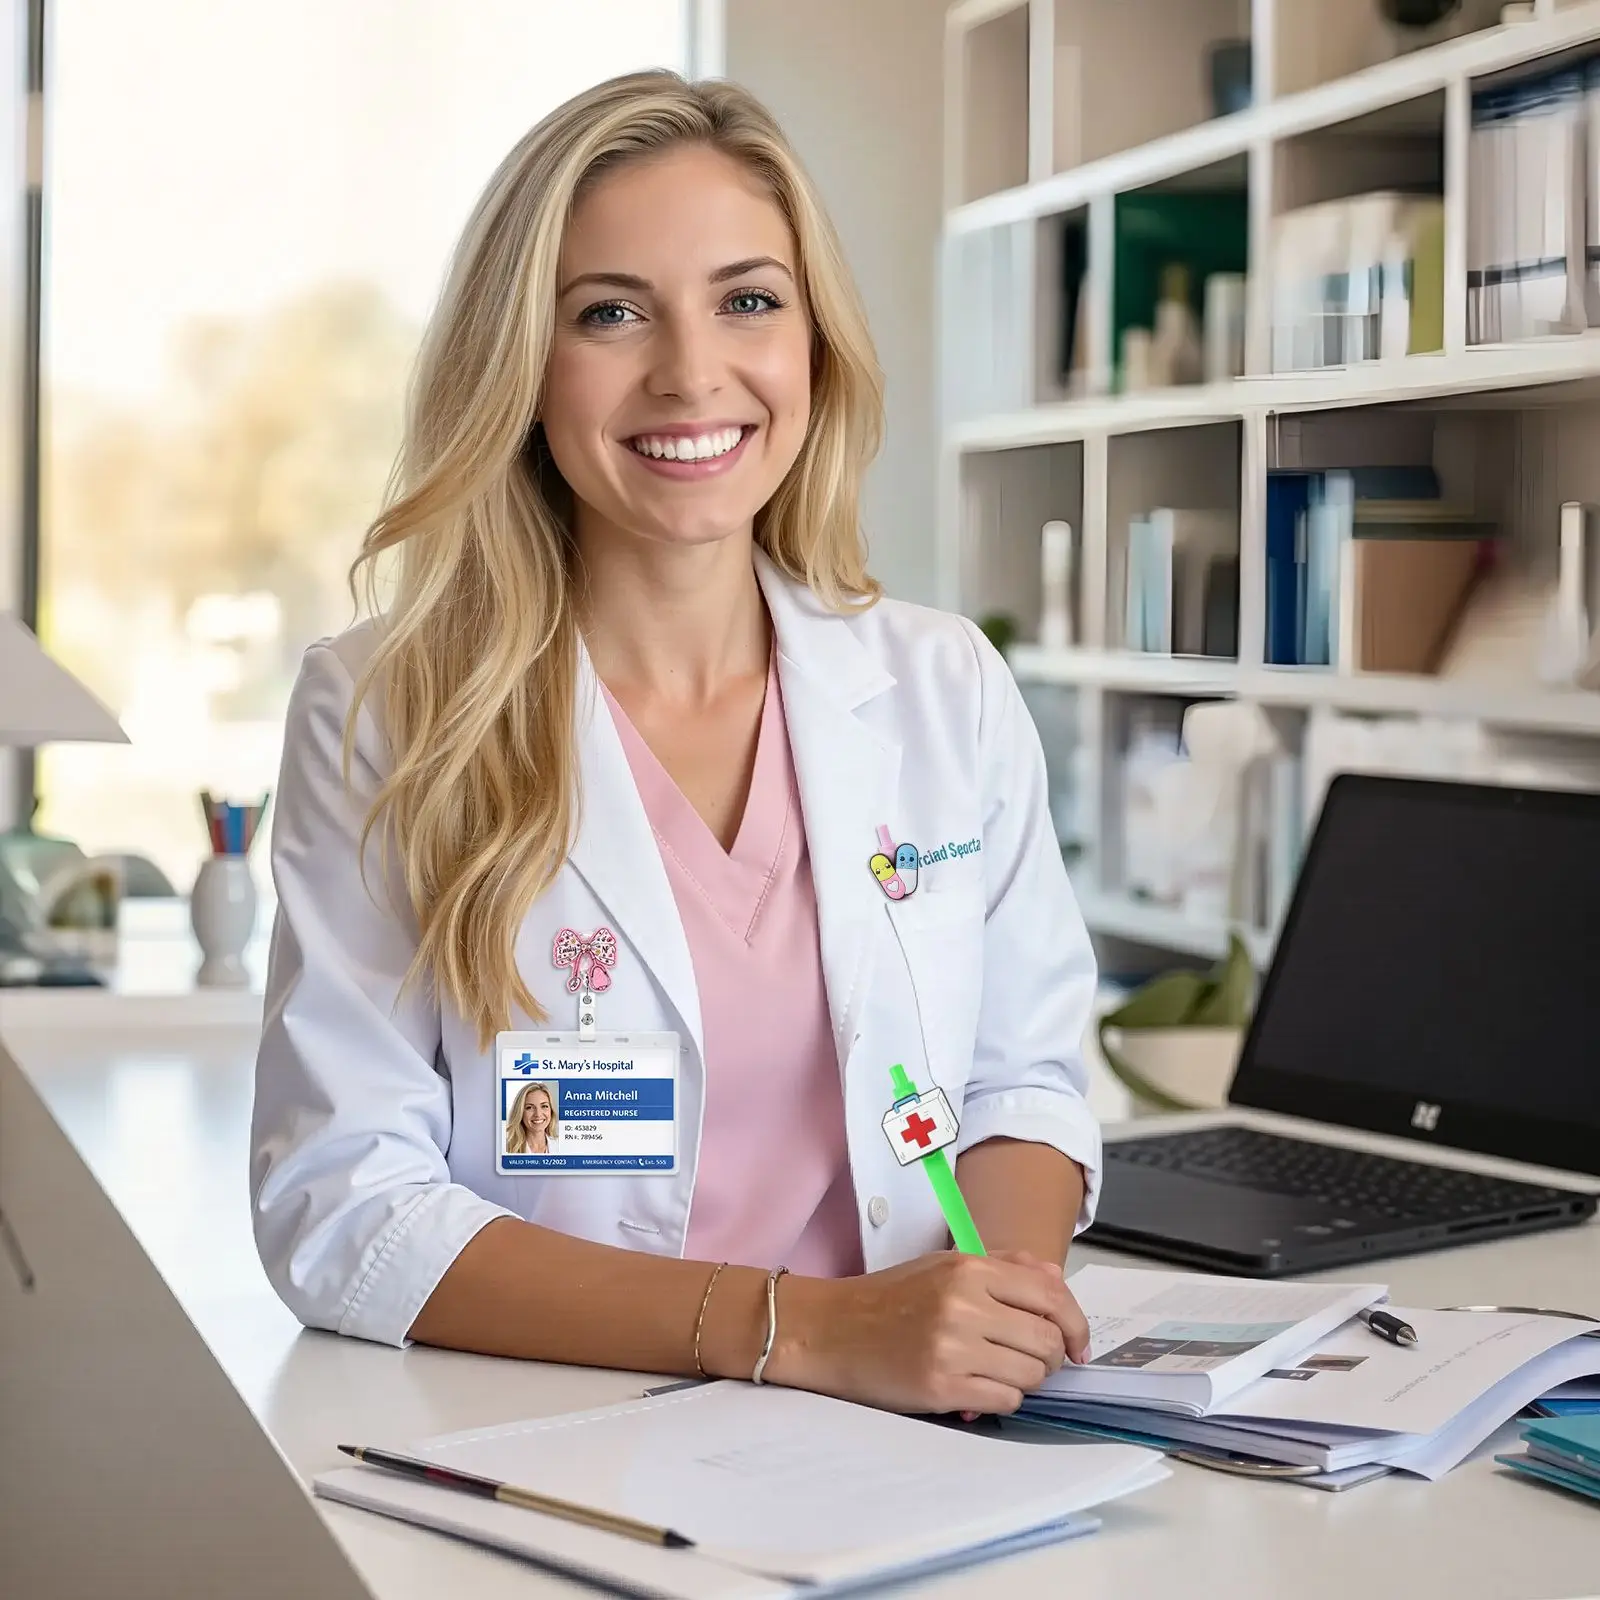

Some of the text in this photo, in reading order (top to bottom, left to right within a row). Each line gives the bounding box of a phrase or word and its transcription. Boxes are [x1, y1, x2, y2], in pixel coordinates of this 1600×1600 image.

[542, 1059, 634, 1072] St. Mary's Hospital
[564, 1090, 638, 1101] Anna Mitchell
[564, 1109, 639, 1117] REGISTERED NURSE
[542, 1158, 567, 1167] 12/2023
